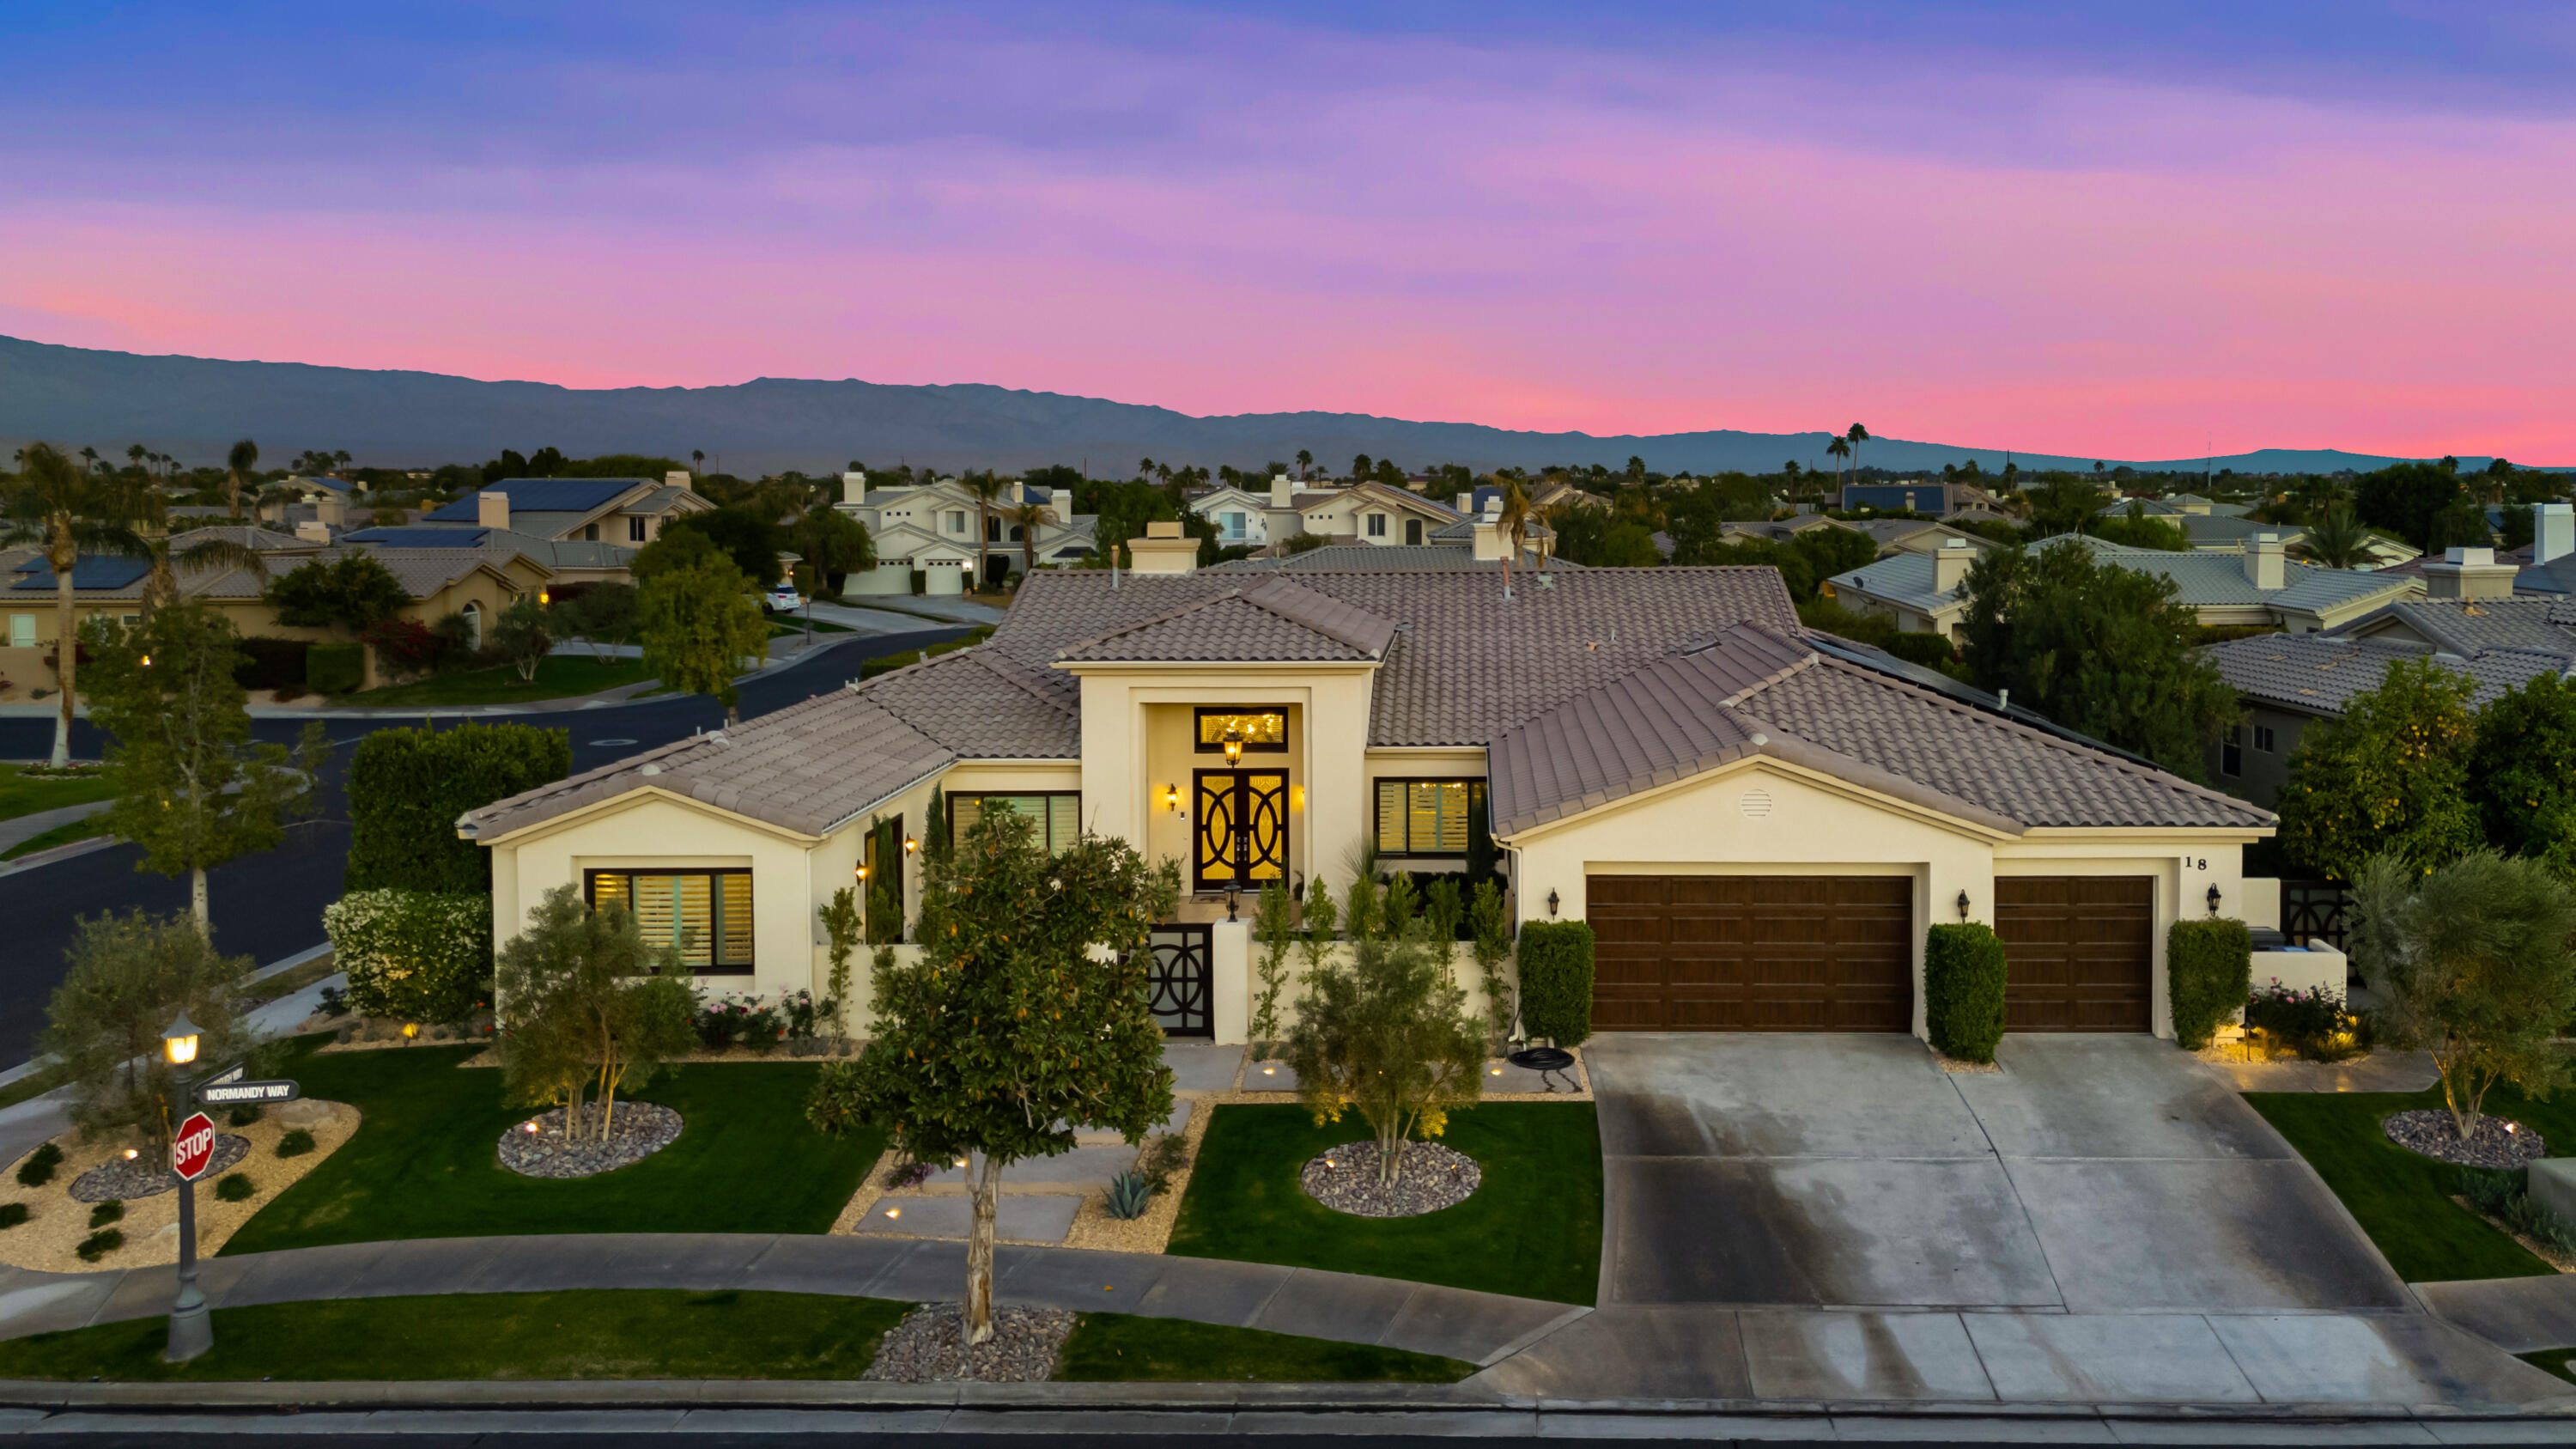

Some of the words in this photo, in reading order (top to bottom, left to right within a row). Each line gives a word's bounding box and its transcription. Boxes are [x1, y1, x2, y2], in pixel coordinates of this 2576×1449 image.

[2185, 856, 2207, 870] 18
[207, 1086, 265, 1101] NORMANDY
[266, 1085, 290, 1098] WAY
[177, 1128, 212, 1165] STOP
